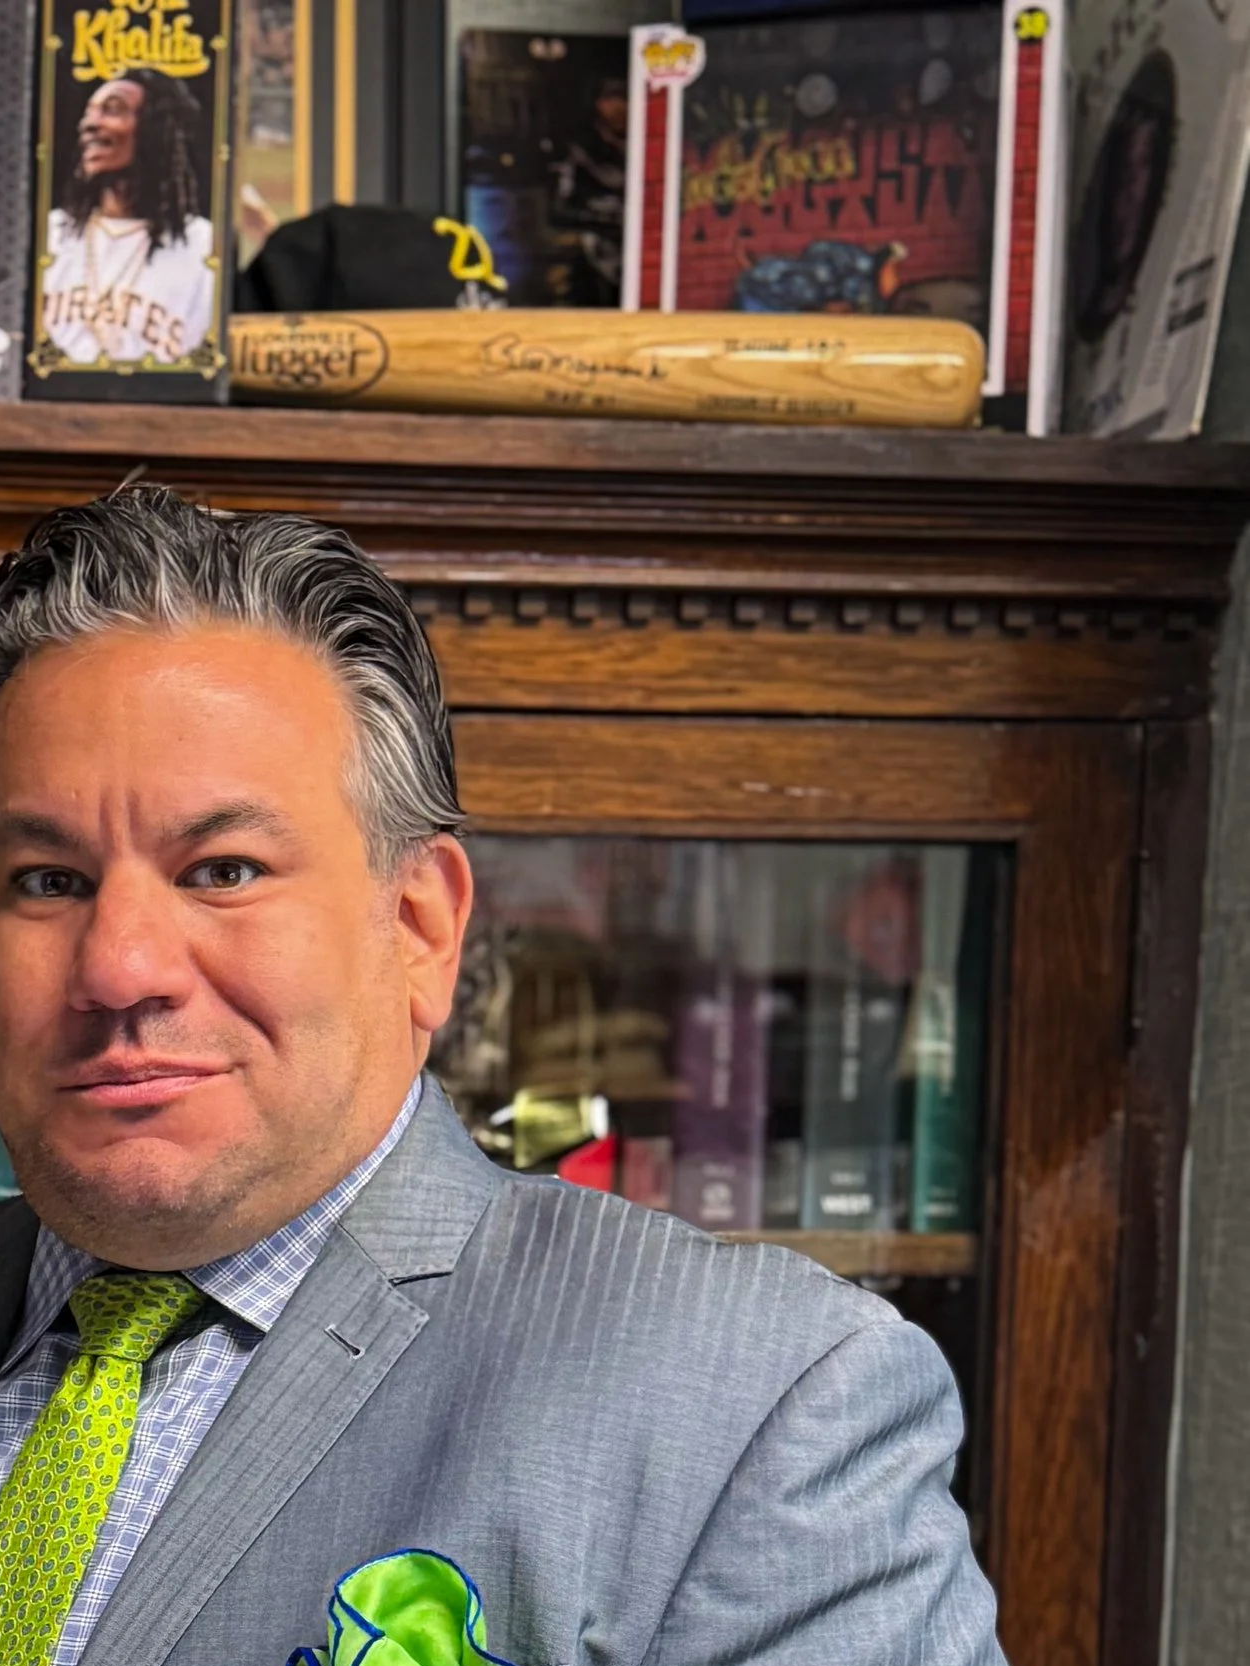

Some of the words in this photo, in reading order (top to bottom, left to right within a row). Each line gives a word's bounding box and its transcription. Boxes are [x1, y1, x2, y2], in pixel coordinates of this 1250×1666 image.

[72, 9, 210, 81] Khalifa
[43, 284, 186, 359] IRATES
[232, 333, 373, 387] lugger
